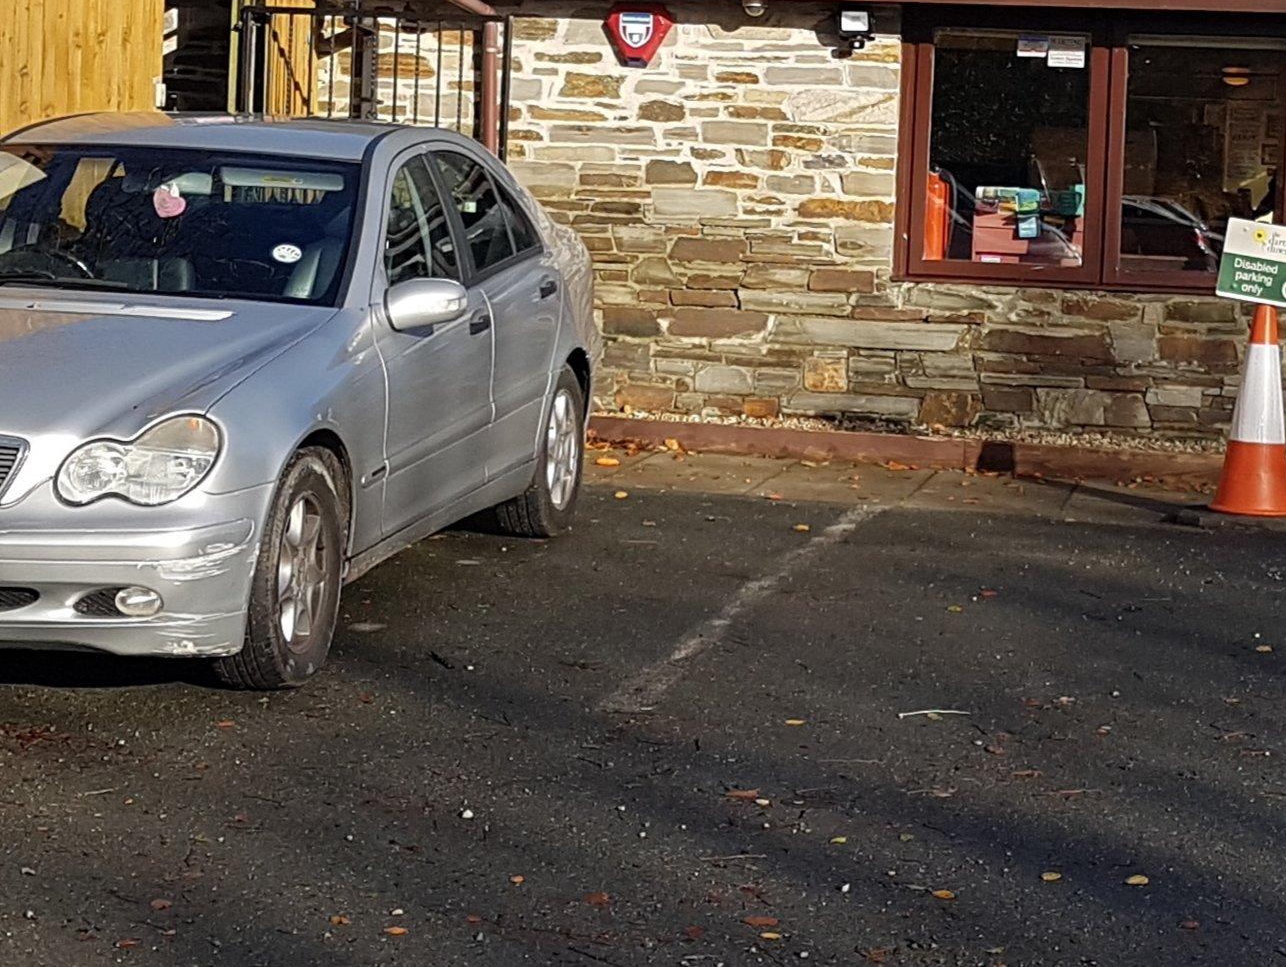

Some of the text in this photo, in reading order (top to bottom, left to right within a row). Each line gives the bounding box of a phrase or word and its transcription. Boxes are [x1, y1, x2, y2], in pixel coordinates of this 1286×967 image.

[1234, 258, 1278, 274] Disabled
[1235, 271, 1273, 287] parking
[1241, 283, 1263, 296] only
